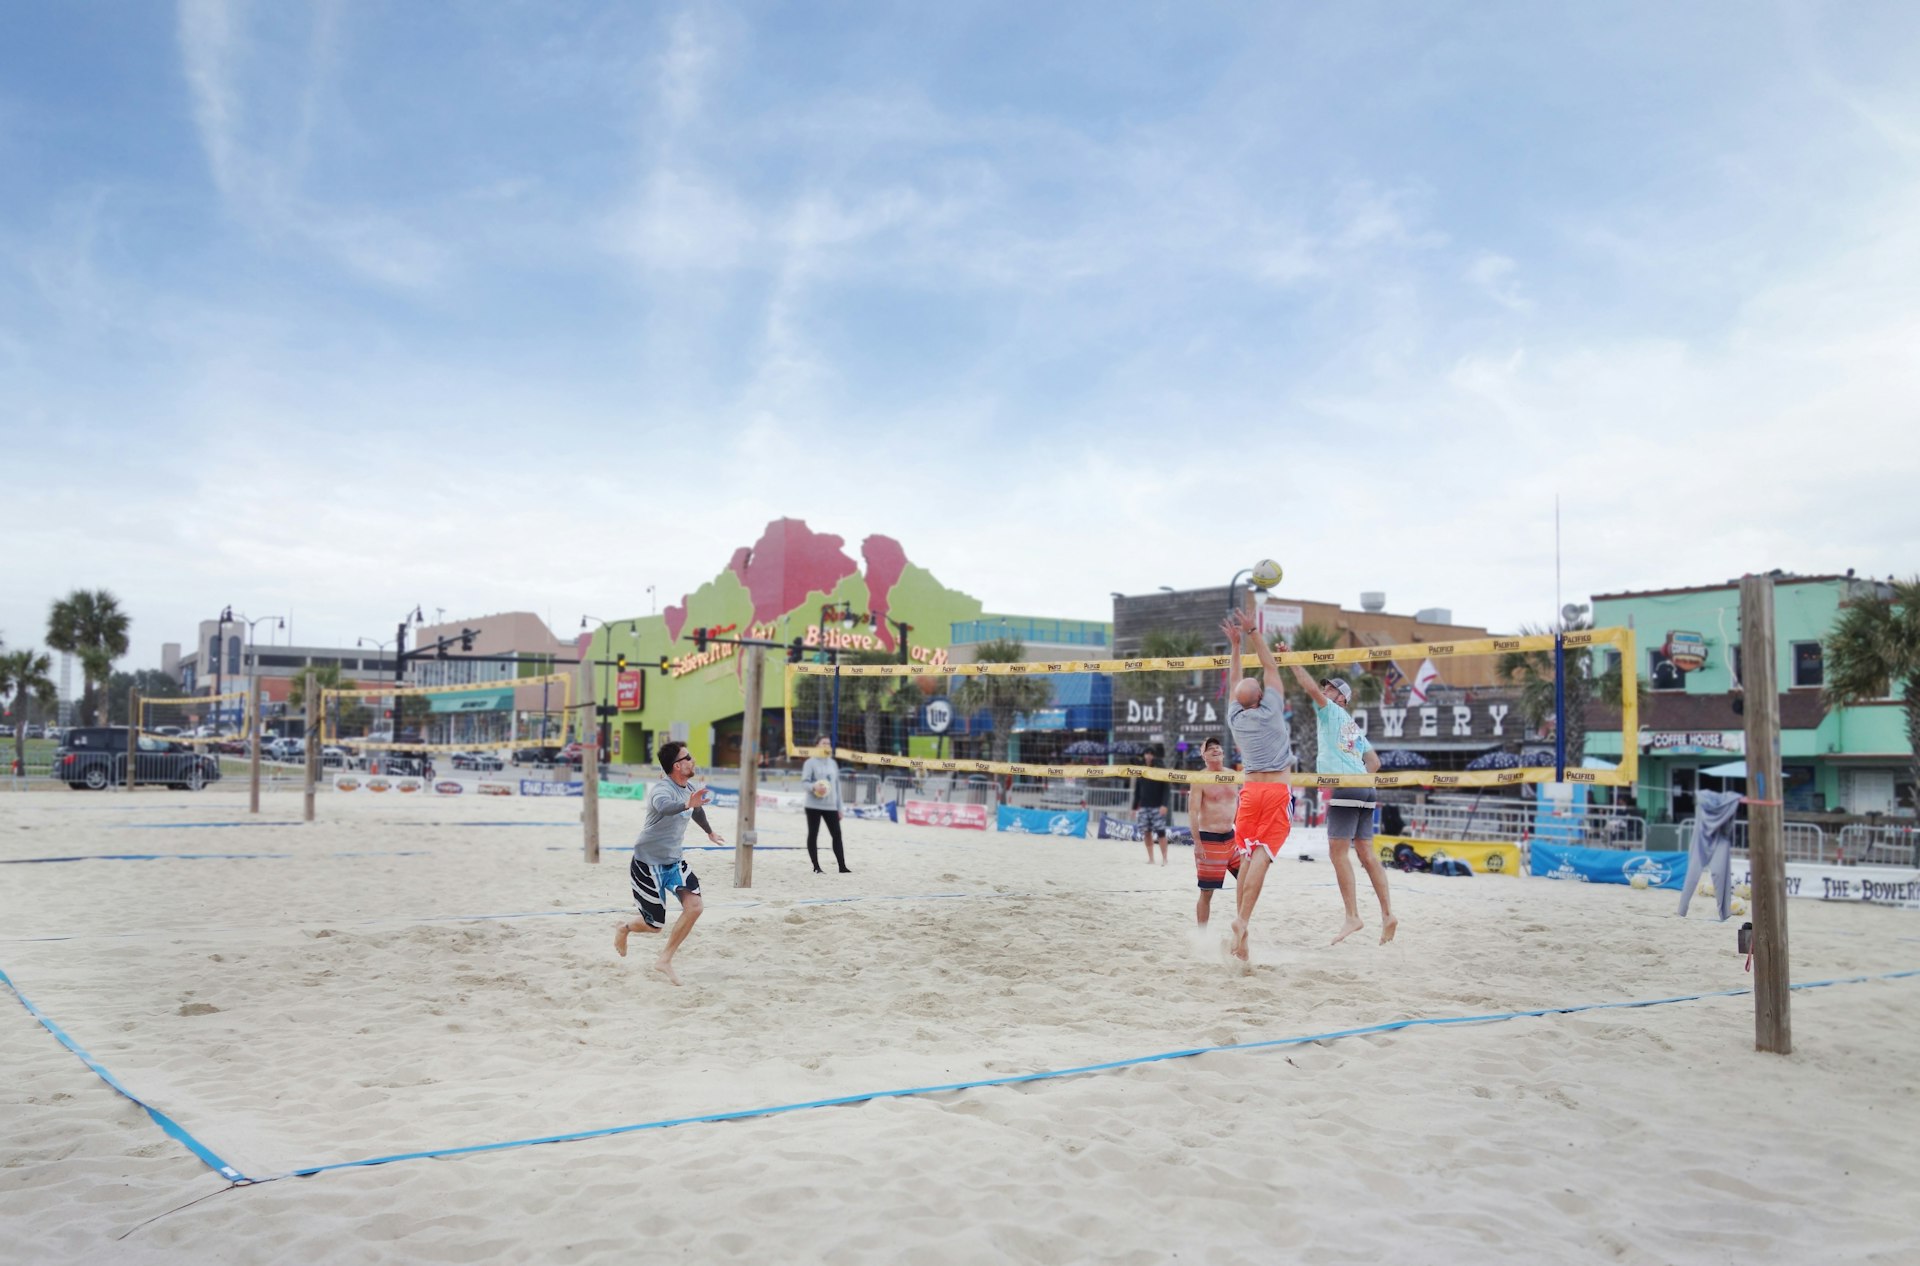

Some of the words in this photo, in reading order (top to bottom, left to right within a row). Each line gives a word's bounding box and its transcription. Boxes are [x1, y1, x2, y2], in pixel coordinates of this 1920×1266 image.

[931, 709, 948, 727] Lite
[1655, 733, 1686, 747] COFFEE
[1689, 733, 1720, 747] HOUSE
[1547, 870, 1590, 882] AMERICA
[1822, 877, 1850, 899] THE
